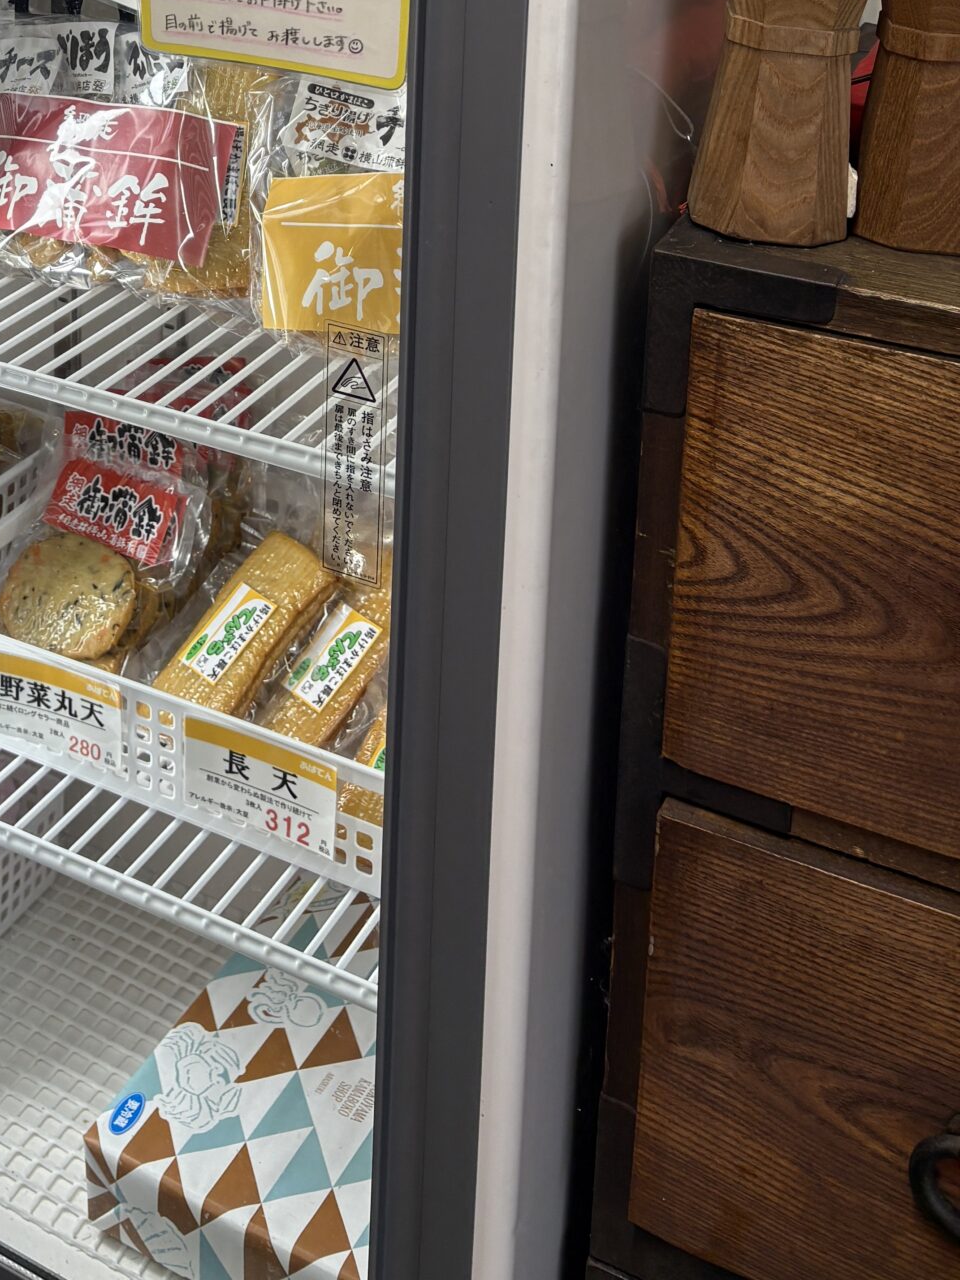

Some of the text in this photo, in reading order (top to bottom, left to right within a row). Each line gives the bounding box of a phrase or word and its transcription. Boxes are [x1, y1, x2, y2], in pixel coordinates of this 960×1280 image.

[304, 96, 375, 124] ちぎり揚げ
[349, 332, 381, 353] 注意
[360, 410, 375, 492] 指はさみ注意
[331, 404, 344, 567] 扉は最後まできちんと閉めてください。
[76, 473, 164, 544] 御蒲鉾
[206, 607, 257, 656] てんぷら
[311, 630, 362, 681] てんぷら
[0, 674, 105, 728] 野菜丸天
[69, 736, 101, 760] 280
[265, 808, 310, 846] 312
[332, 1081, 352, 1103] SHOP
[338, 1077, 372, 1118] KAMABOKO
